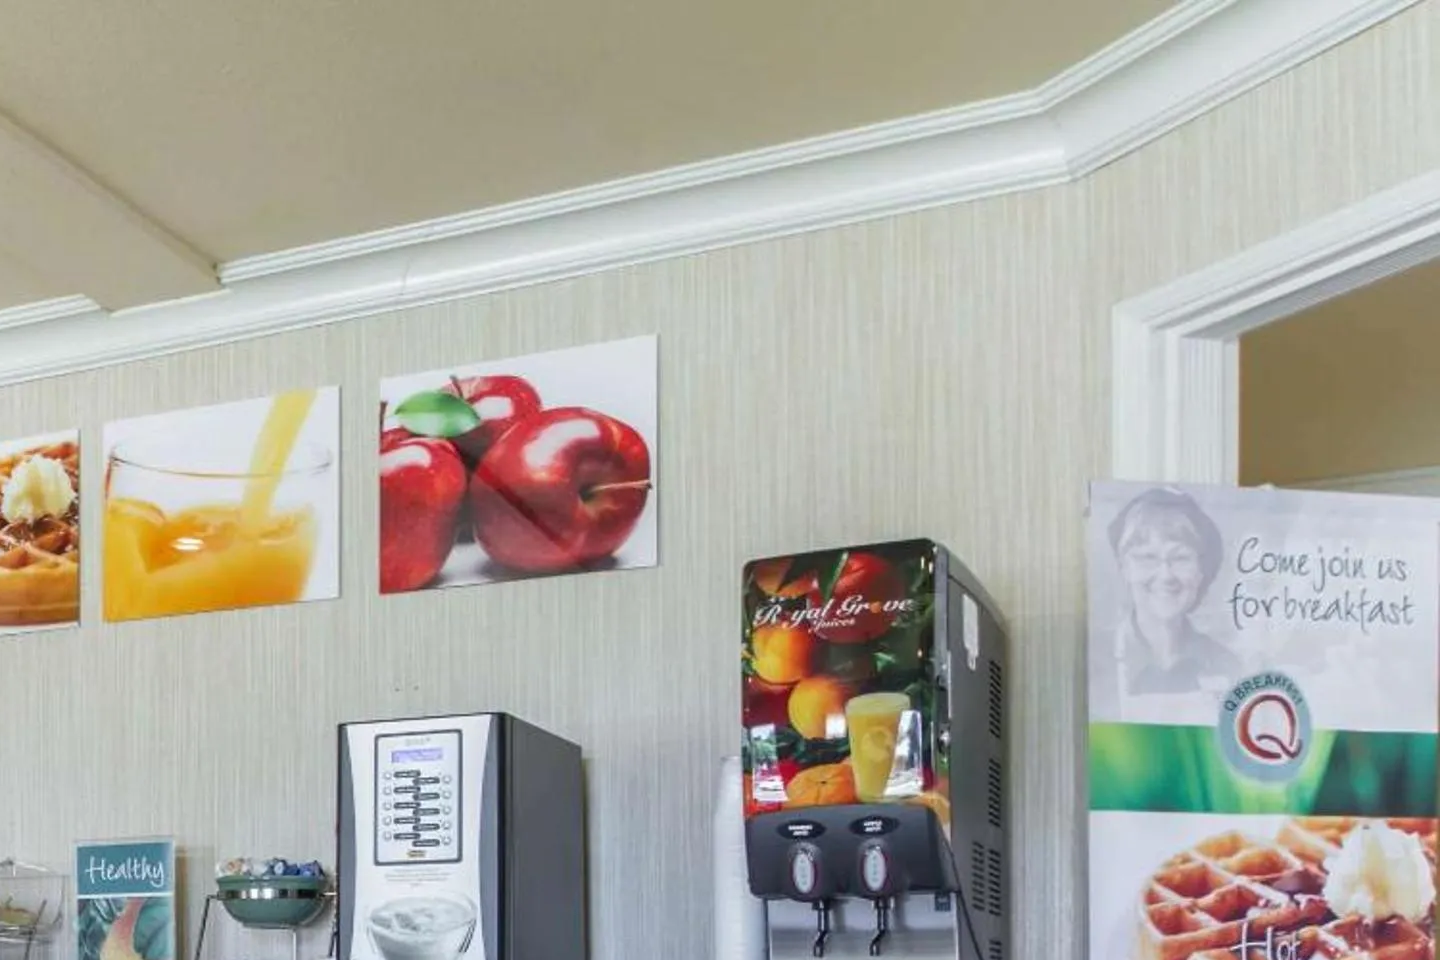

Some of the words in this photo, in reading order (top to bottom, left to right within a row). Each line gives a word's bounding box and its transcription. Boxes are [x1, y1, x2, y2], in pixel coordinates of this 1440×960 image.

[1236, 536, 1310, 575] Come
[1313, 546, 1365, 592] join
[1377, 557, 1408, 582] us
[1227, 582, 1281, 631] for
[1283, 586, 1415, 634] breakfast
[1238, 694, 1304, 759] Q
[84, 855, 165, 888] Healthy
